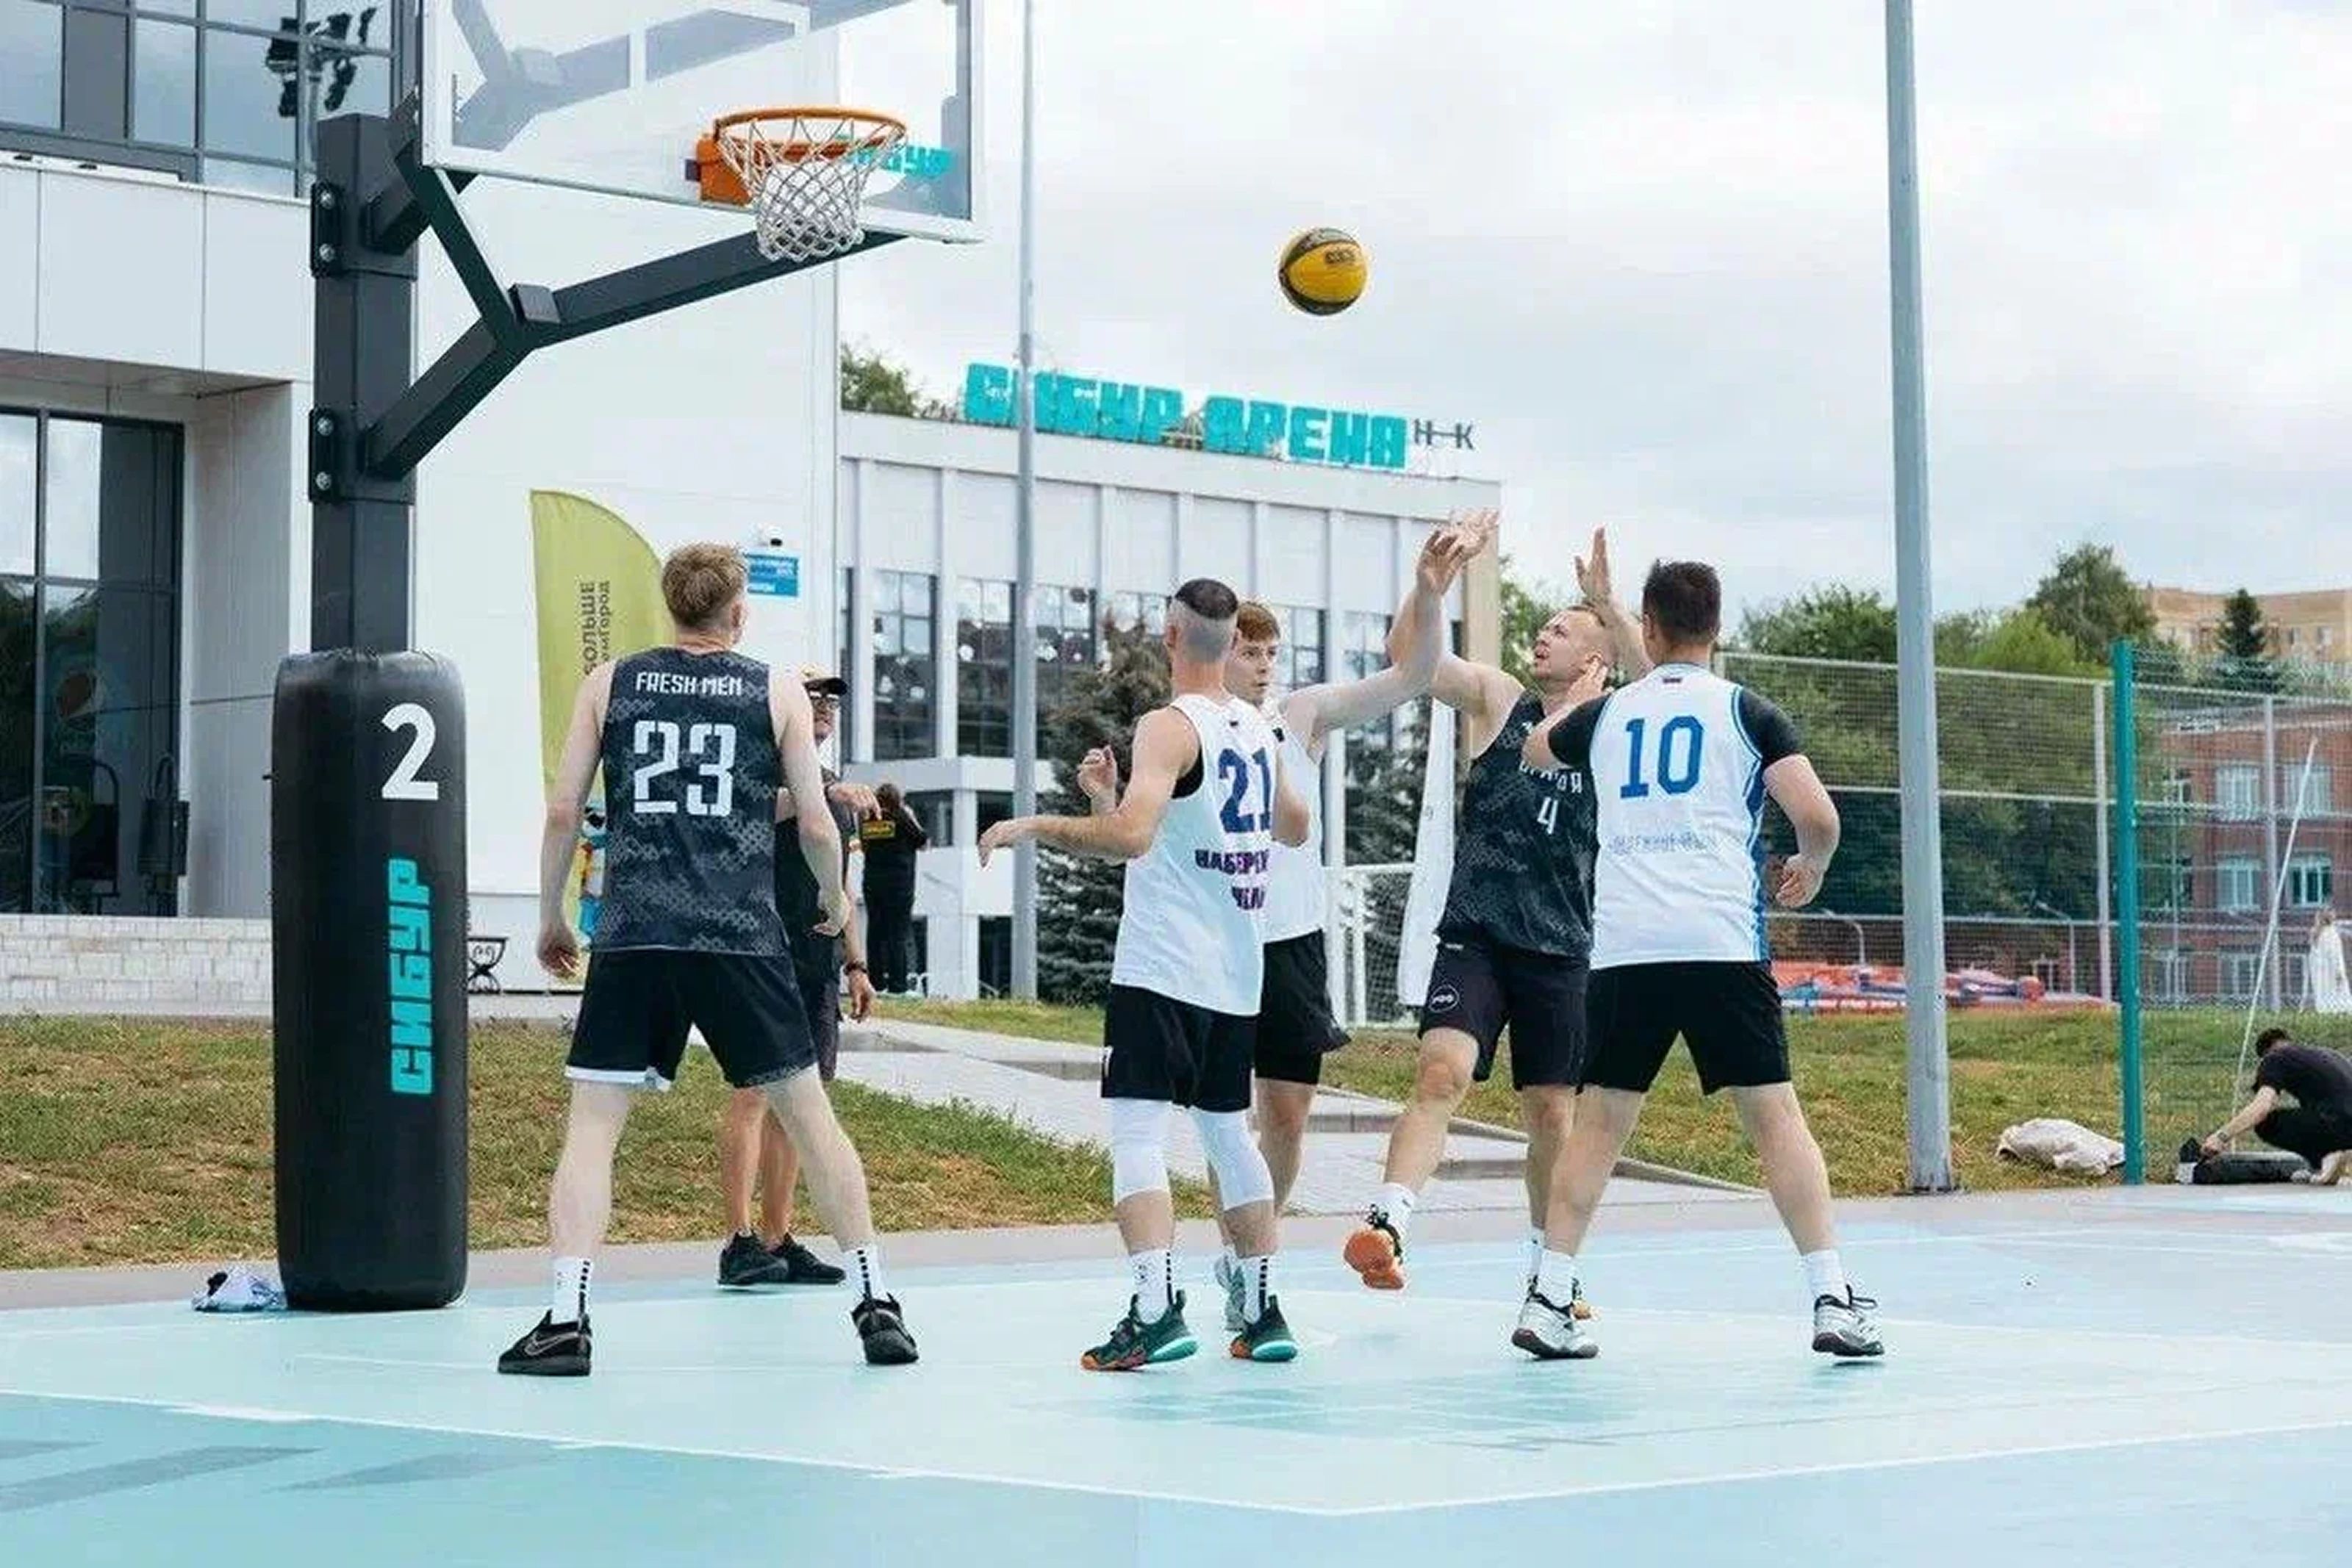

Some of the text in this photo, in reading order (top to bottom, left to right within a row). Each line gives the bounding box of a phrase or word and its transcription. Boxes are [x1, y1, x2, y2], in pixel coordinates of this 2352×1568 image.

[1203, 396, 1408, 469] АРЕНА
[637, 672, 742, 697] FRESH MEN
[381, 702, 439, 801] 2
[634, 720, 736, 816] 23
[1217, 748, 1272, 833] 21
[1620, 716, 1704, 799] 10
[1537, 796, 1558, 835] 4
[388, 858, 432, 1095] СИБУР
